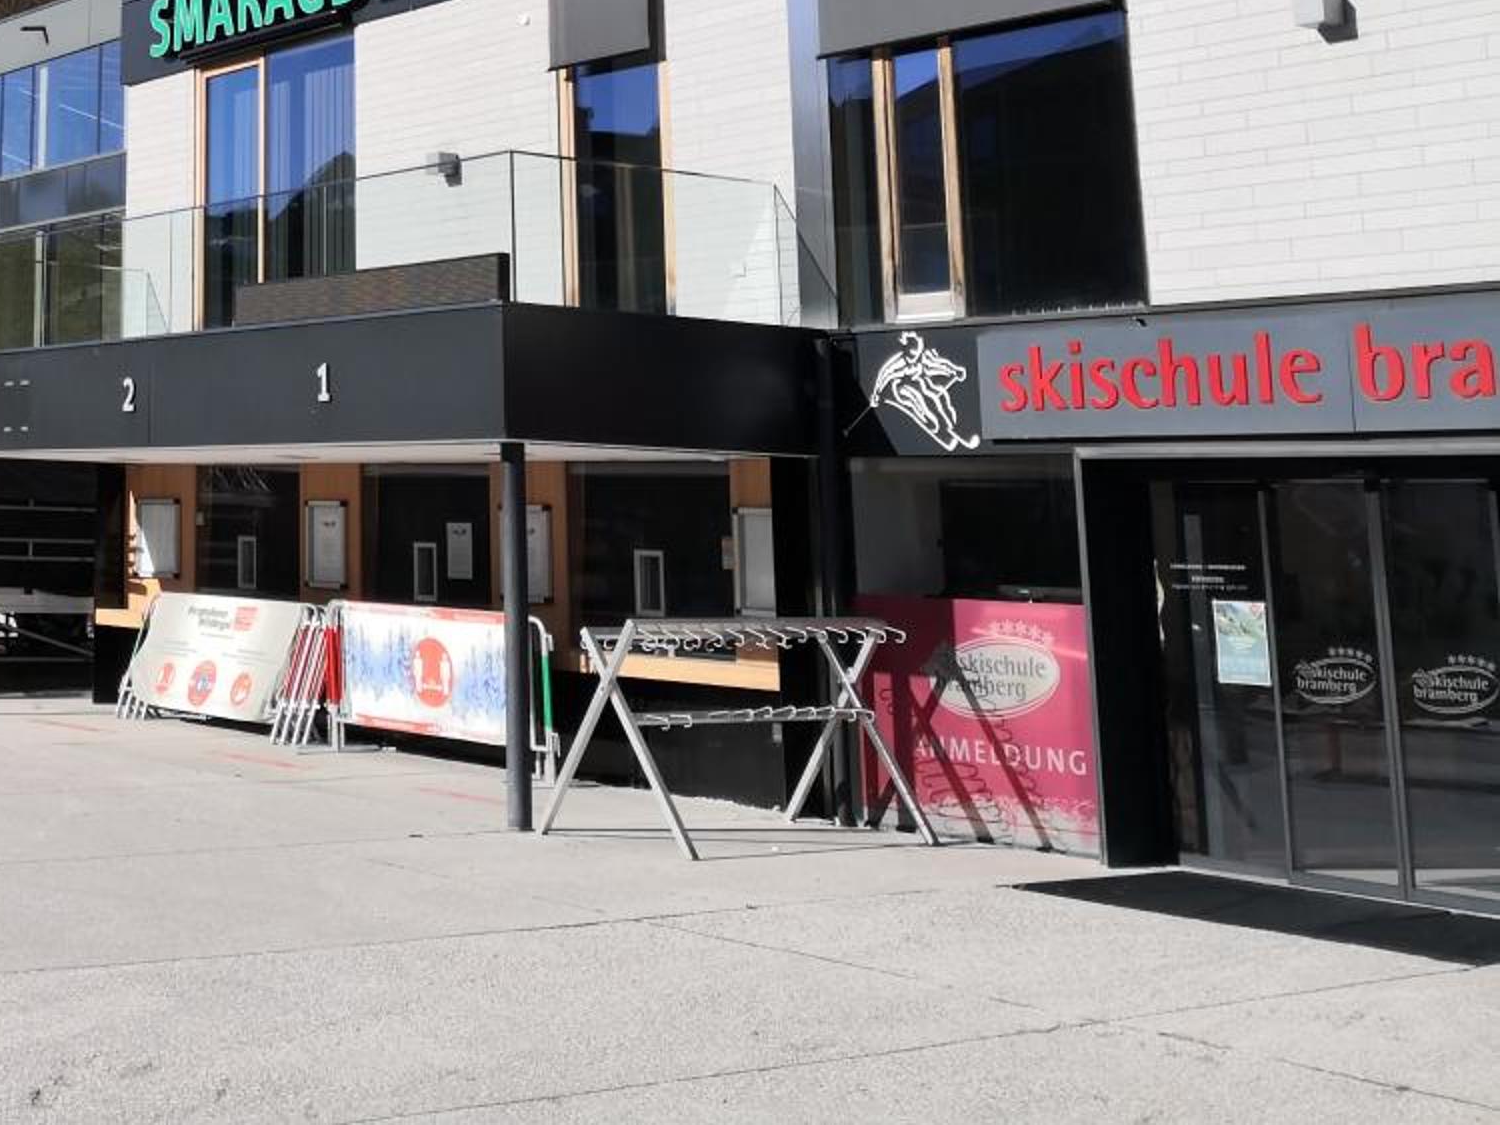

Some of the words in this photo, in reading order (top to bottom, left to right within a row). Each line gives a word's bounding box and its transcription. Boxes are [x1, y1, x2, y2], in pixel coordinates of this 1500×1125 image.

[1000, 329, 1323, 413] skischule
[1353, 321, 1497, 402] bra
[122, 376, 136, 412] 2
[317, 362, 331, 402] 1
[959, 650, 1045, 677] skischule
[1297, 677, 1357, 694] bramberg
[1412, 685, 1477, 703] bramberg
[915, 733, 1088, 776] ANMELDUNG
